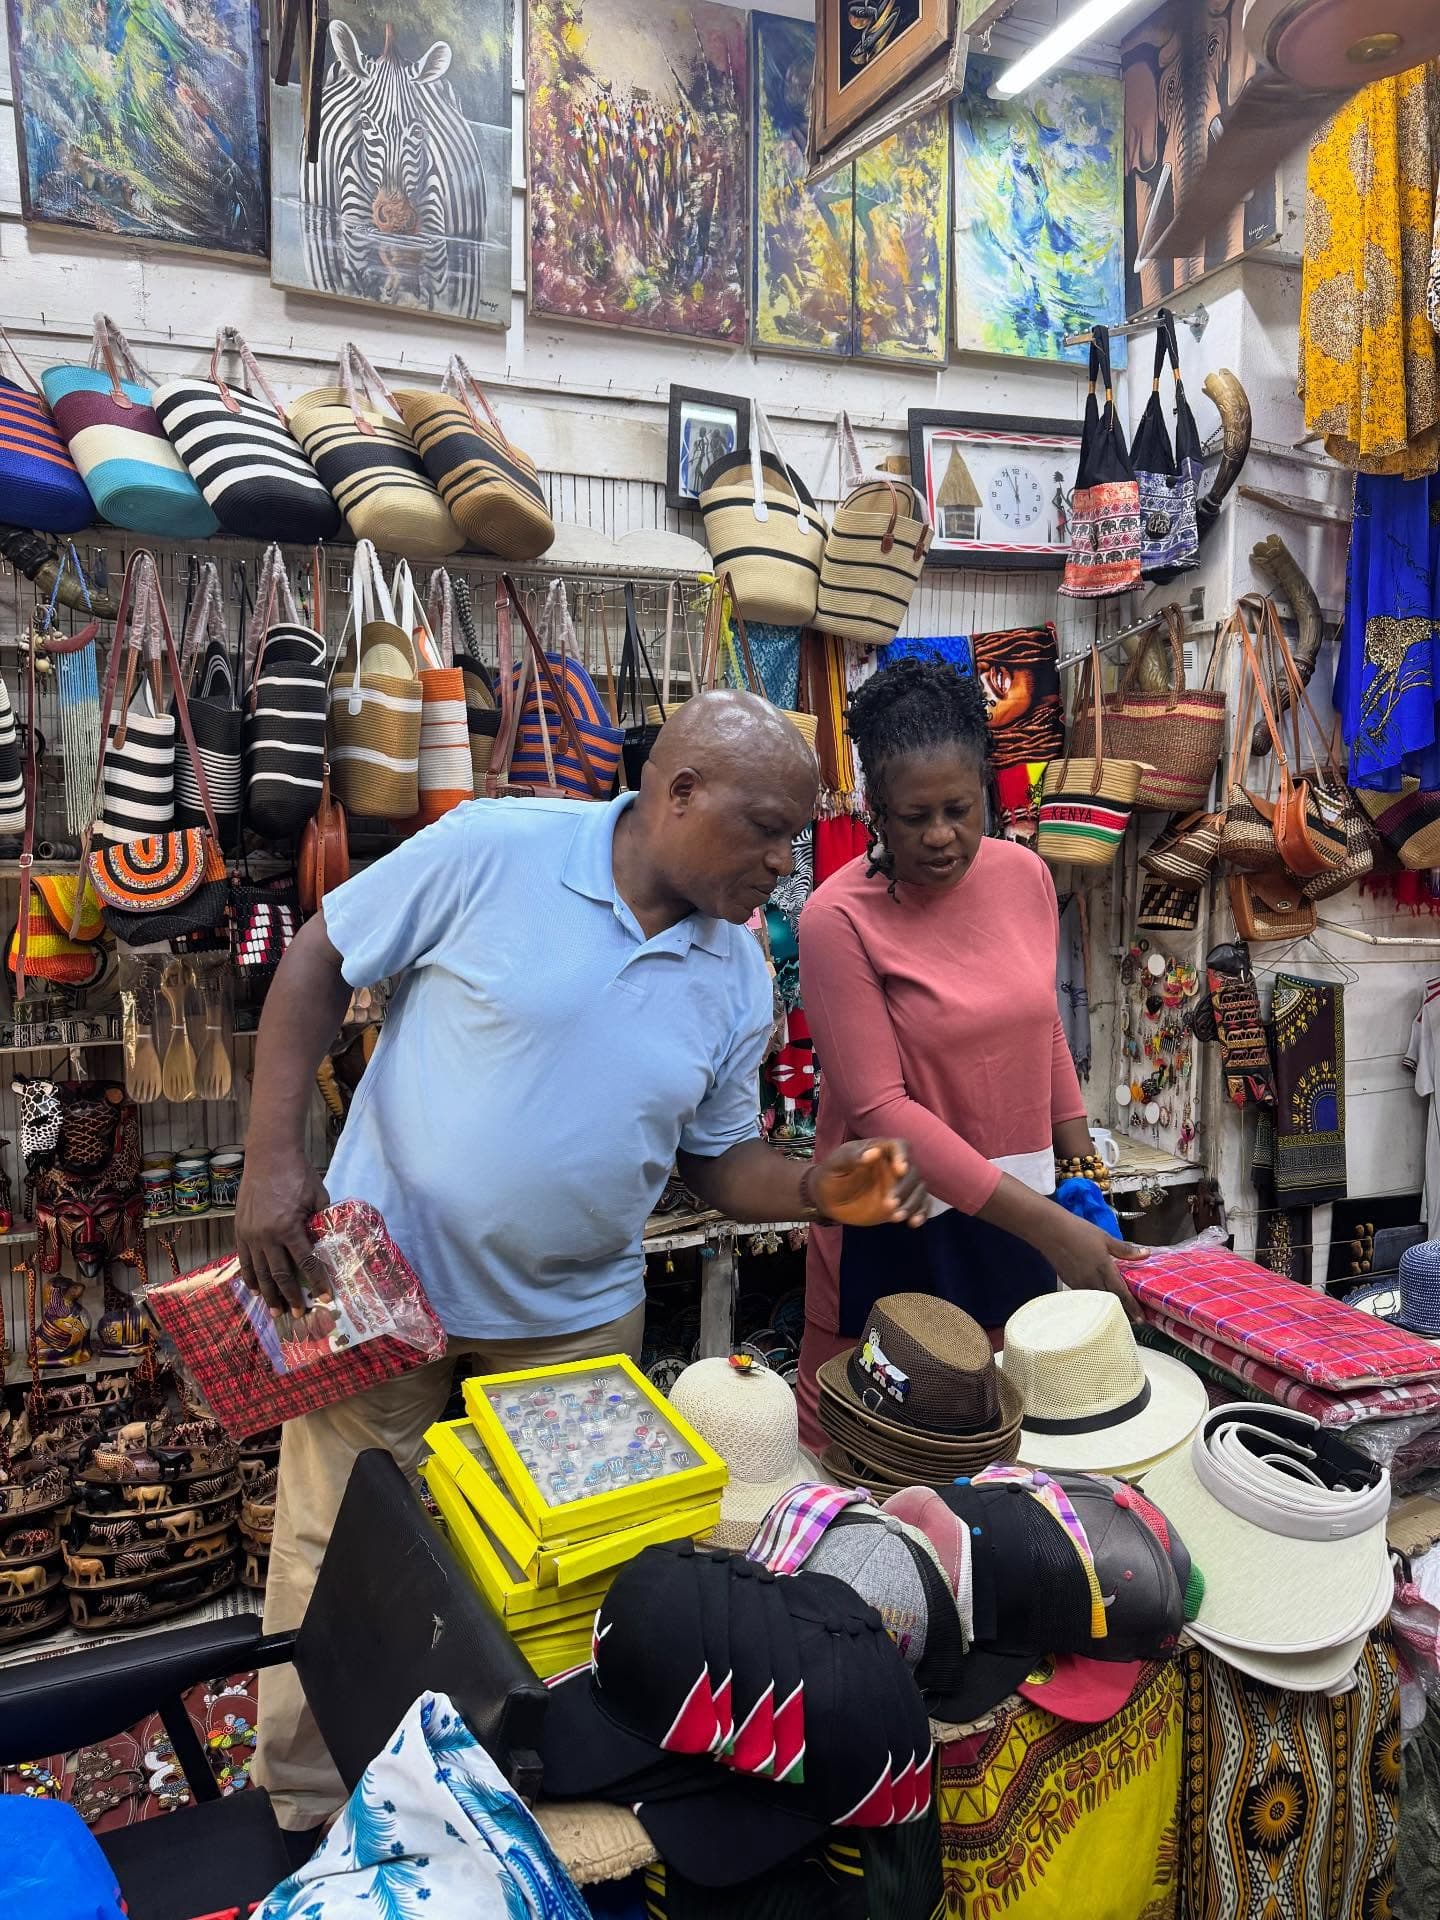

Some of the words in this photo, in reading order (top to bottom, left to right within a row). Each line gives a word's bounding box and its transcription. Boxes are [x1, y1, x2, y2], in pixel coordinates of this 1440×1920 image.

[1024, 472, 1029, 480] 1
[994, 479, 1003, 487] 10
[1031, 482, 1038, 490] 2
[1014, 517, 1020, 525] 6
[1051, 805, 1092, 824] KENYA
